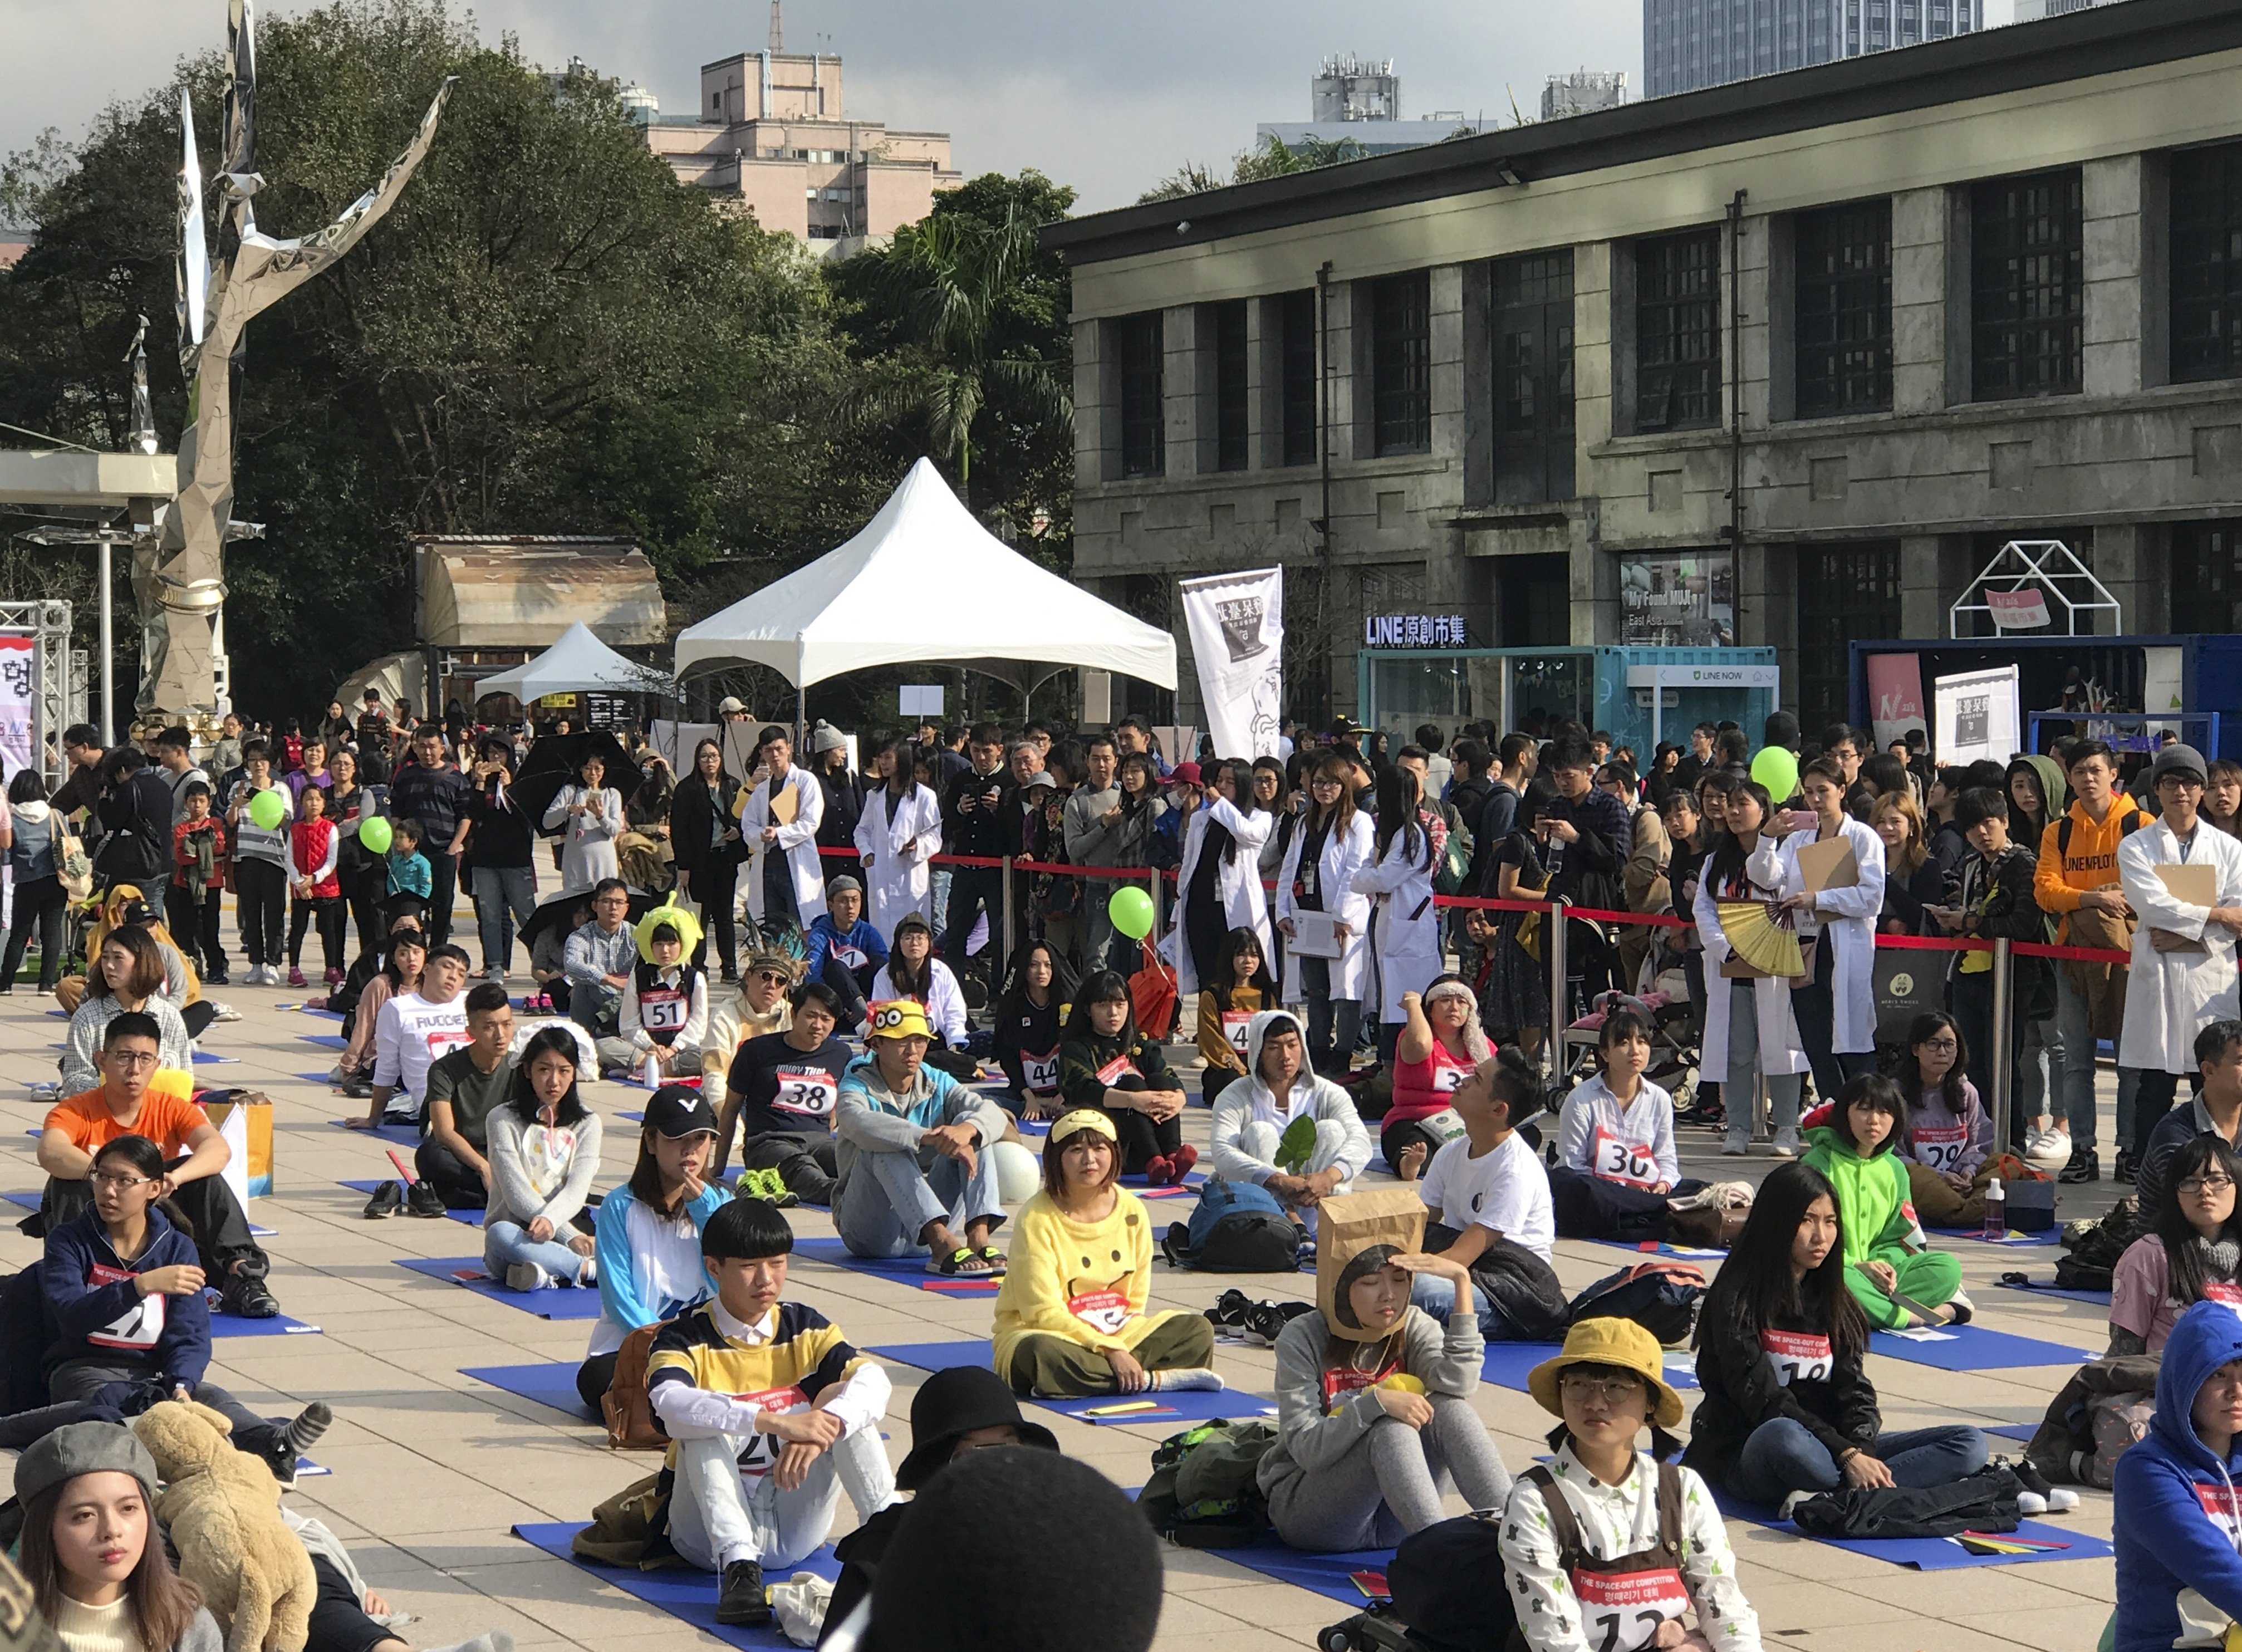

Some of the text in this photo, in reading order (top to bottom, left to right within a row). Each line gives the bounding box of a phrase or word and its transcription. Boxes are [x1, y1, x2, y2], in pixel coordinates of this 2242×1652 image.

[839, 950, 855, 967] 7
[653, 1003, 678, 1026] 51
[1233, 1026, 1248, 1047] 4
[1033, 1058, 1057, 1085] 44
[786, 1084, 826, 1111] 38
[1608, 1145, 1649, 1177] 30
[1782, 1337, 1815, 1346] SPACE-OUT
[1581, 1575, 1676, 1590] THE SPACE-OUT COMPETITION
[1605, 1587, 1659, 1602] 멍때리기 대회
[1596, 1609, 1665, 1652] 12
